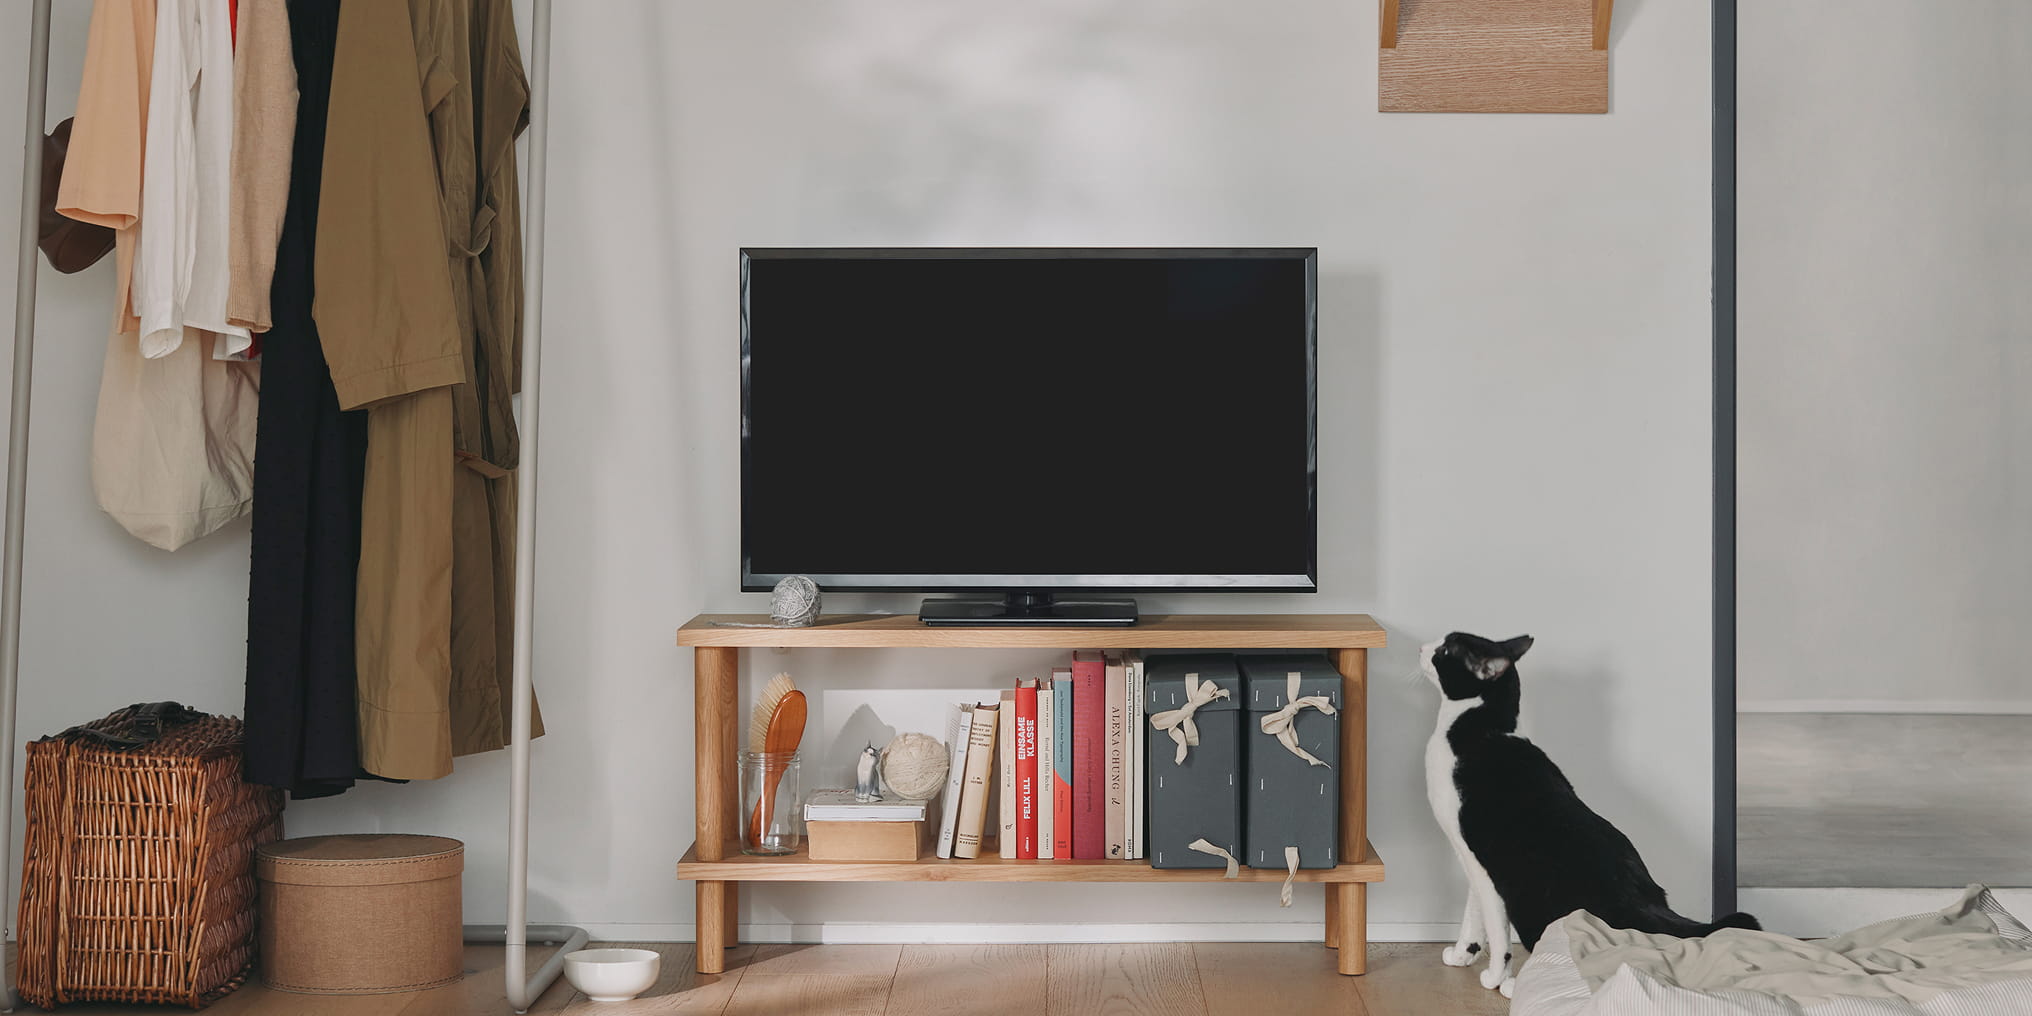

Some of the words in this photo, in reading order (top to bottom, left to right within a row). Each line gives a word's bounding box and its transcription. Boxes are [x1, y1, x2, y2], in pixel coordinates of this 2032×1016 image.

[1017, 716, 1026, 760] EINSAME
[1026, 719, 1035, 757] KLASSE
[1111, 706, 1120, 746] ALEXA
[1023, 776, 1031, 795] LILL
[1111, 749, 1120, 790] CHUNG
[1023, 796, 1031, 820] FELIX
